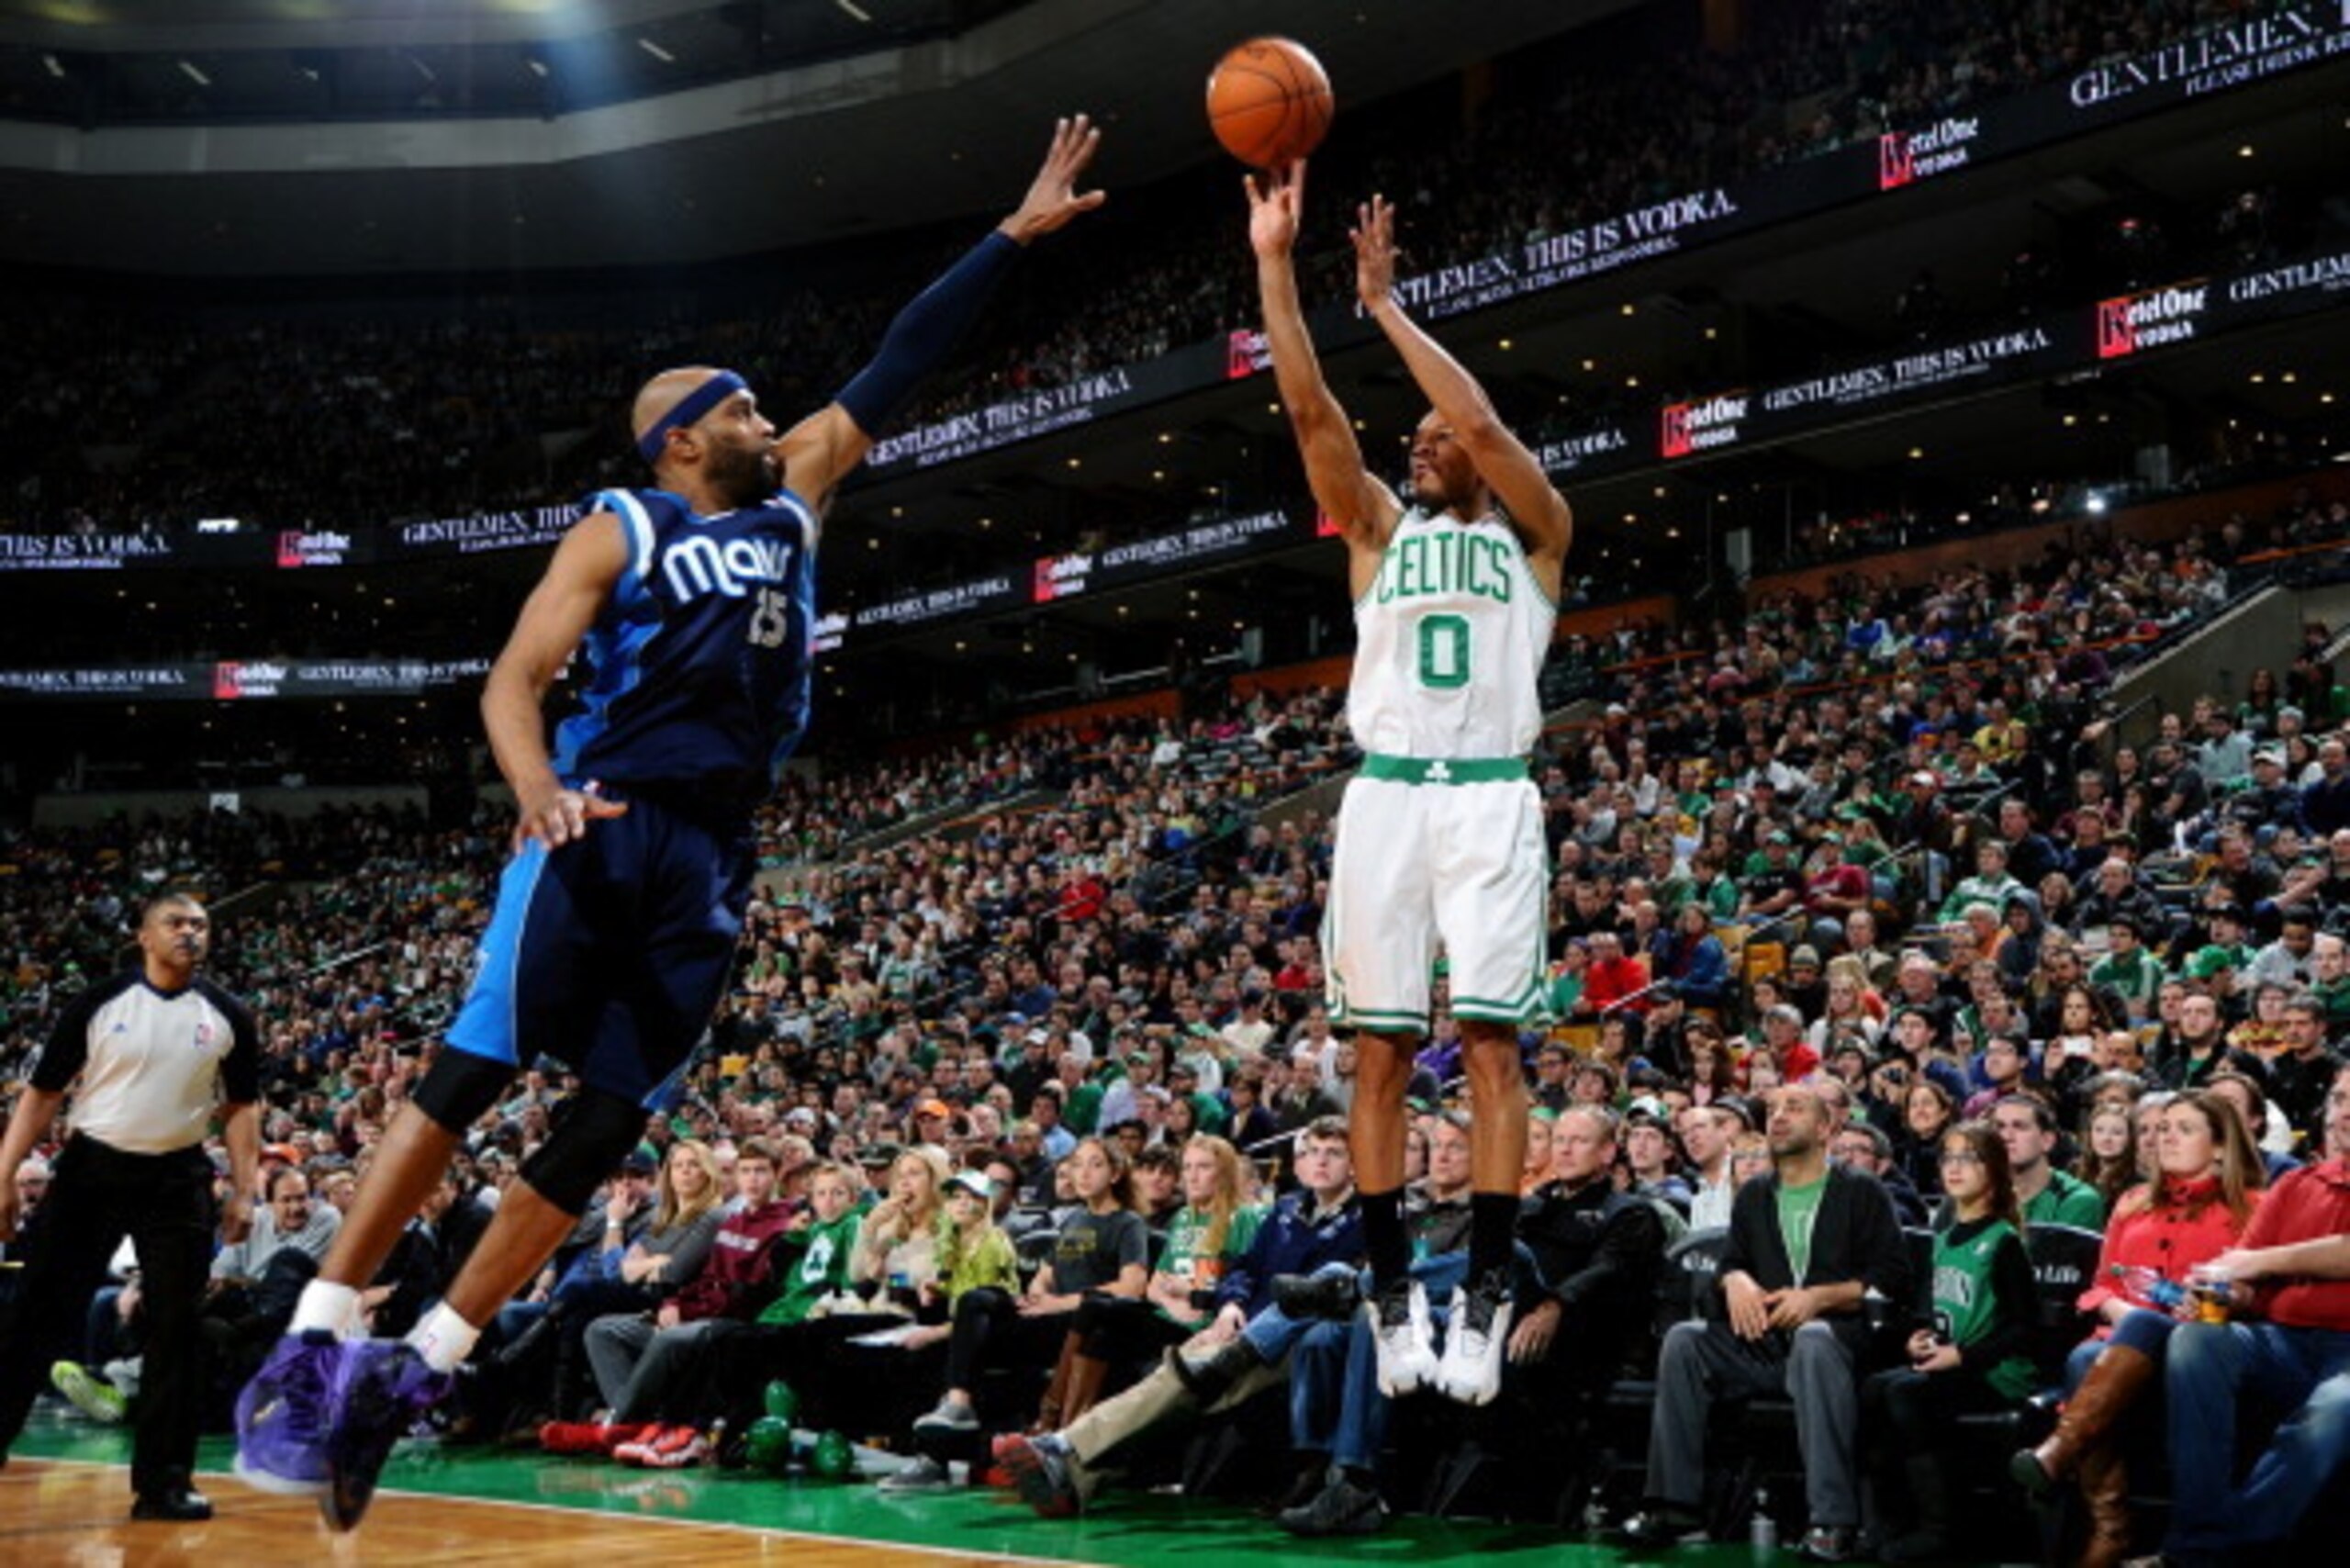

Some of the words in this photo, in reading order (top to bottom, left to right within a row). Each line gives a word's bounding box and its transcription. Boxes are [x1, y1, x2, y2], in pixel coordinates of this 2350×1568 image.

[1524, 229, 1587, 271] THIS
[1593, 218, 1621, 252] IS
[1378, 531, 1511, 604] CELTICS
[1419, 612, 1471, 689] 0
